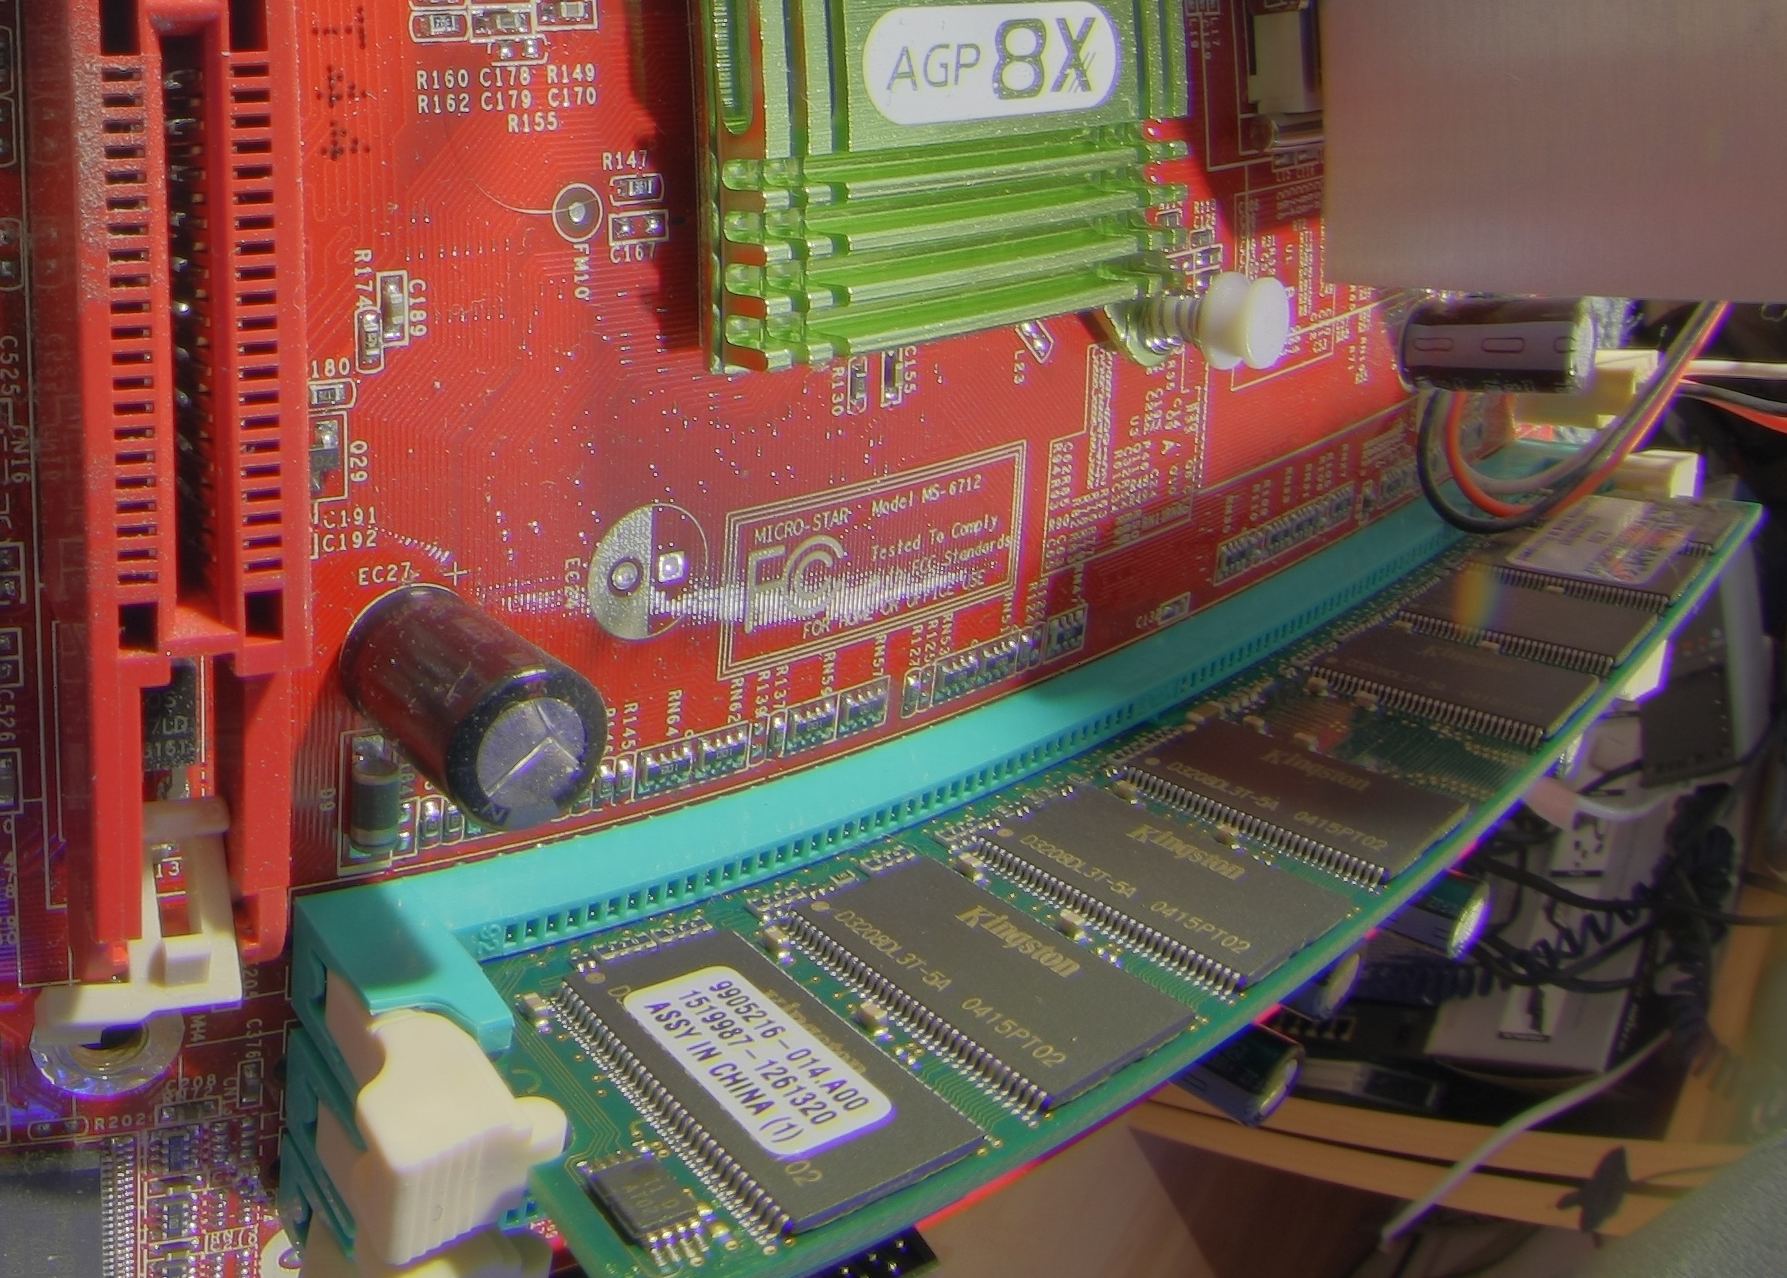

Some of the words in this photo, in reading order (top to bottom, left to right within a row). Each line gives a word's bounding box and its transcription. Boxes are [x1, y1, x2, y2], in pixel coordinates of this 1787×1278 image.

[415, 69, 470, 91] R160
[478, 66, 532, 89] C178
[545, 63, 597, 85] R149
[887, 42, 982, 92] AGP
[992, 16, 1097, 100] 8X
[416, 92, 471, 115] R162
[479, 89, 534, 111] C179
[546, 87, 598, 109] C170
[506, 112, 560, 134] R155
[601, 150, 649, 172] R147
[352, 248, 373, 312] R174
[572, 243, 591, 301] FM10
[407, 278, 428, 338] C189
[0, 334, 21, 397] C525
[8, 424, 32, 486] CN16
[871, 490, 915, 518] Model
[920, 473, 983, 505] MS-6712
[321, 528, 378, 553] C192
[753, 506, 851, 546] MICRO-STAR
[870, 534, 922, 563] Tested
[928, 527, 945, 545] To
[357, 561, 413, 587] EC27
[961, 568, 986, 591] USE
[1260, 747, 1374, 793] Kingston
[1125, 823, 1250, 883] Kingston
[1292, 809, 1390, 852] 0415PT02
[1019, 832, 1139, 901] D3208DL3T-5A
[833, 909, 954, 994] D3208DL3T-5A
[954, 903, 1083, 979] Kingston
[1149, 900, 1253, 956] 0415PT02
[960, 996, 1068, 1070] 0415PT02
[644, 1000, 703, 1043] ASSY
[686, 1039, 722, 1063] IN
[708, 1061, 776, 1117] CHINA
[759, 1115, 804, 1144] (1)
